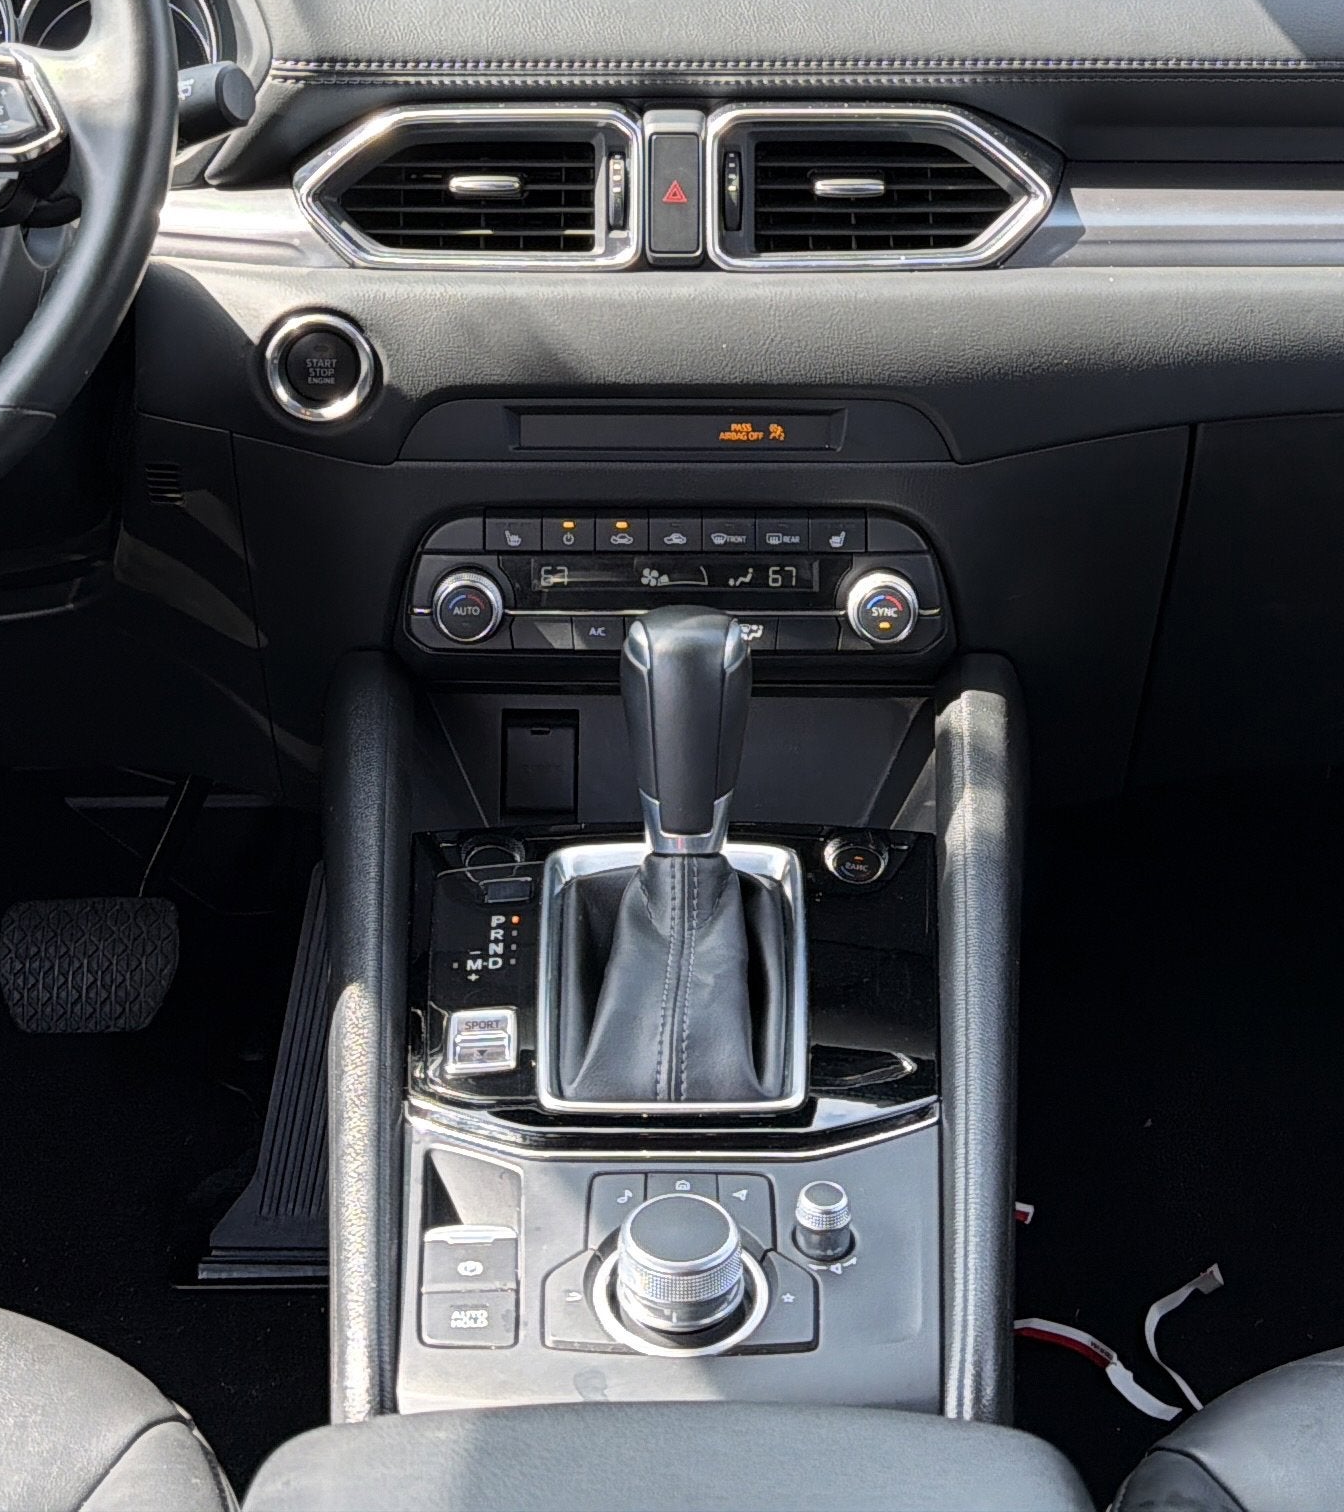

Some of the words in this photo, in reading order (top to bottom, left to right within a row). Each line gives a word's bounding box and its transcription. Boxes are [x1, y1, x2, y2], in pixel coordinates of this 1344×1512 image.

[305, 358, 338, 368] START
[308, 368, 335, 377] STOP
[307, 377, 336, 385] ENGINE
[730, 423, 753, 432] PASS
[719, 431, 747, 441] AIRBAG
[748, 431, 765, 441] OFF
[726, 535, 747, 543] FRONT
[782, 535, 801, 543] REAR
[539, 565, 569, 588] 67
[768, 566, 797, 587] 67
[452, 605, 481, 617] AUTO
[870, 606, 899, 619] SYNC
[588, 626, 607, 638] A/C
[490, 915, 506, 928] P
[489, 929, 505, 940] R
[488, 942, 504, 955] N
[464, 1019, 502, 1031] SPORT
[451, 1309, 489, 1320] AUTO
[450, 1318, 489, 1328] HOLD
